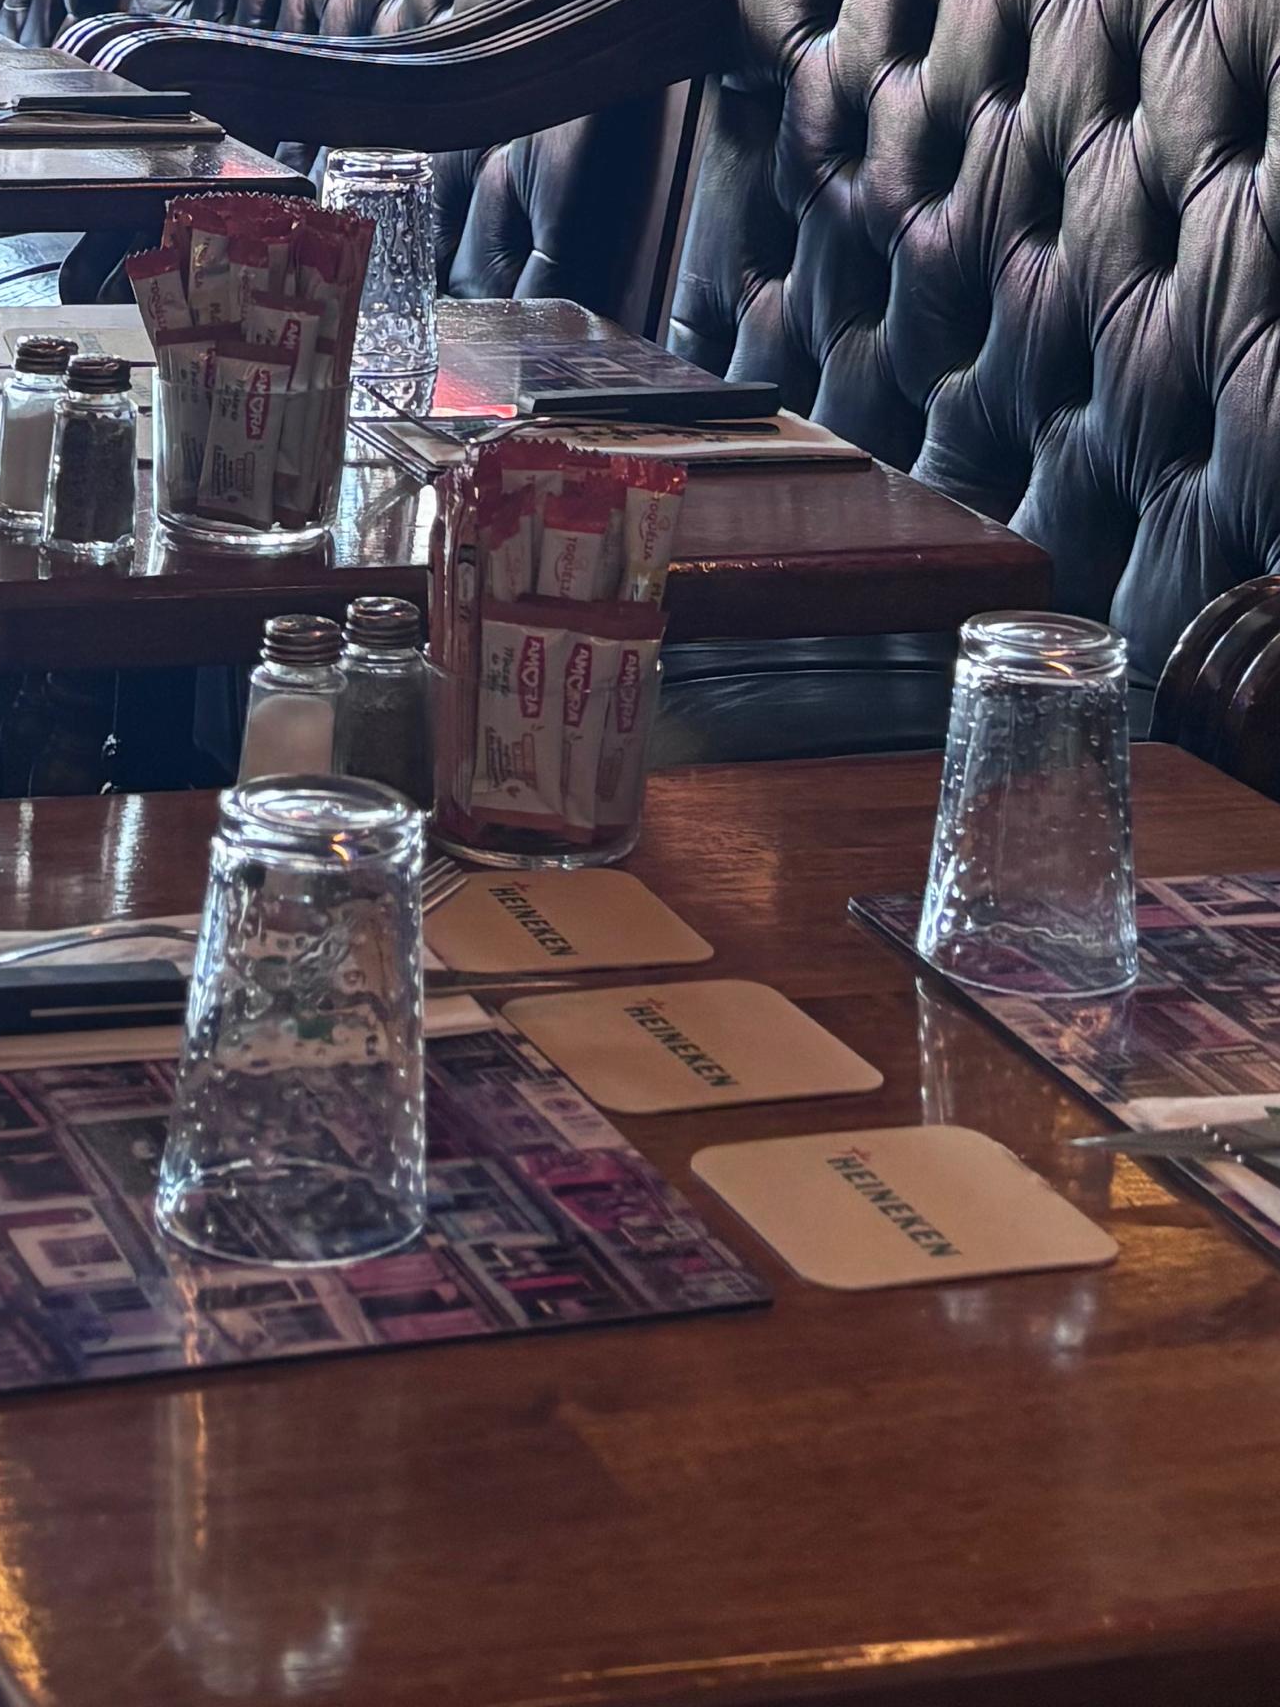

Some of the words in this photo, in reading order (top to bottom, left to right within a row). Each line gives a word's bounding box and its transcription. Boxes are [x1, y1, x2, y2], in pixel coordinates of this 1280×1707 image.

[520, 639, 542, 714] AMORA
[489, 886, 578, 957] HEINEKEN
[624, 1005, 740, 1088] HEINEKEN
[826, 1155, 964, 1257] HEINEKEN
